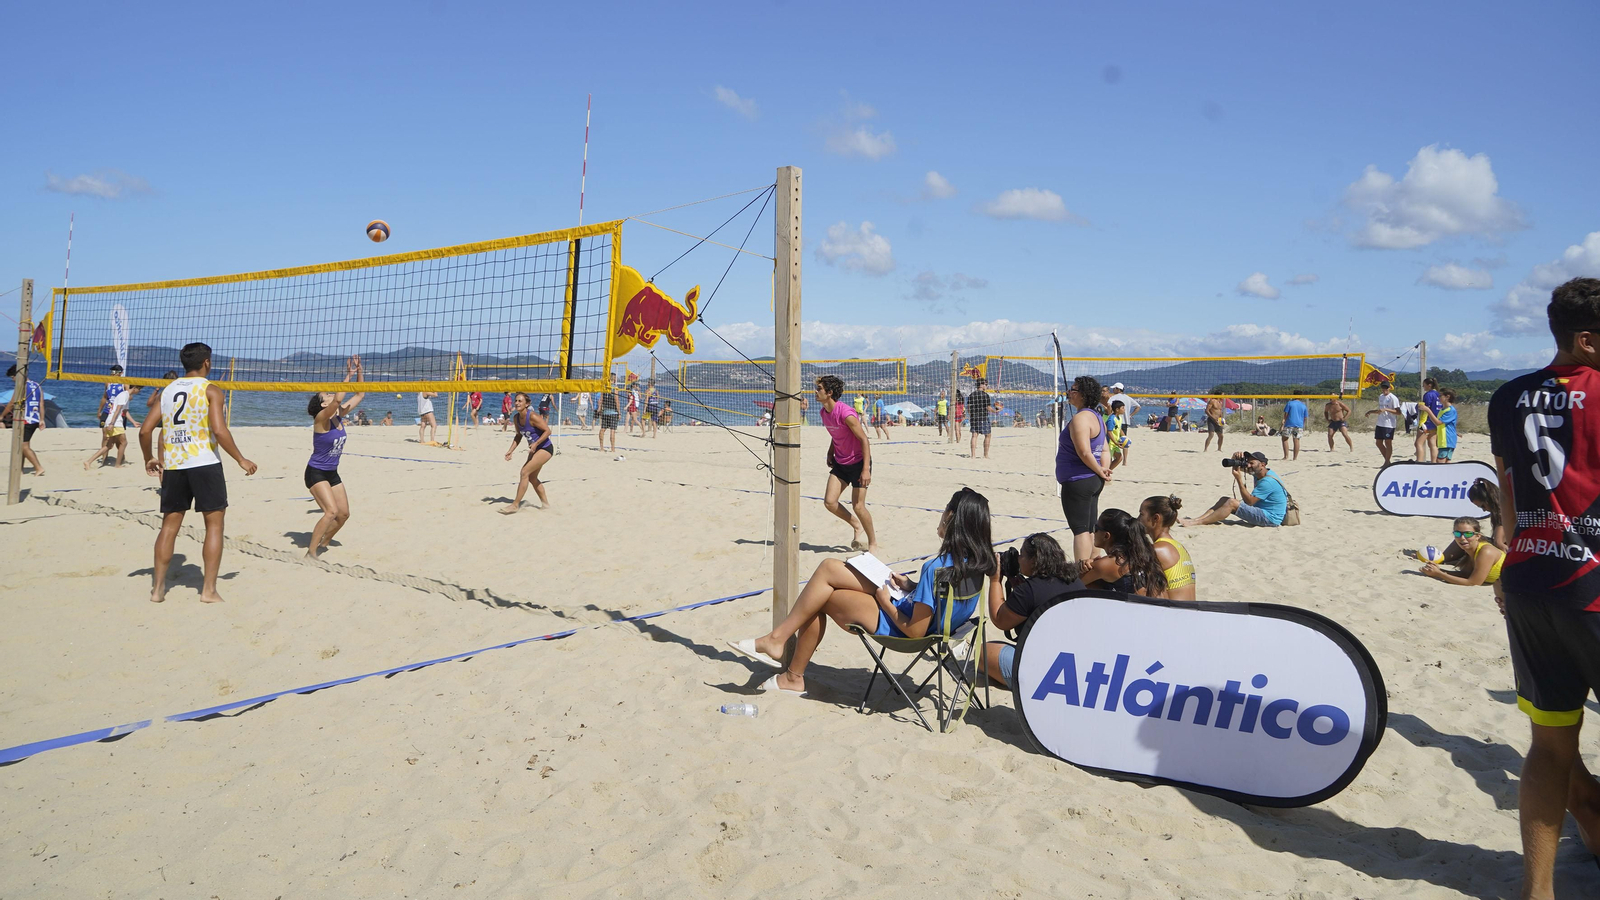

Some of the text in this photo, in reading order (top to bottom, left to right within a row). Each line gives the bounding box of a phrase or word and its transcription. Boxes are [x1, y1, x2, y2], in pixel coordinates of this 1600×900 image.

[173, 391, 188, 425] 2
[1515, 390, 1586, 410] AITOR
[1524, 413, 1566, 490] 5
[1381, 479, 1471, 500] Atlánti
[1031, 651, 1351, 746] Atlántico
